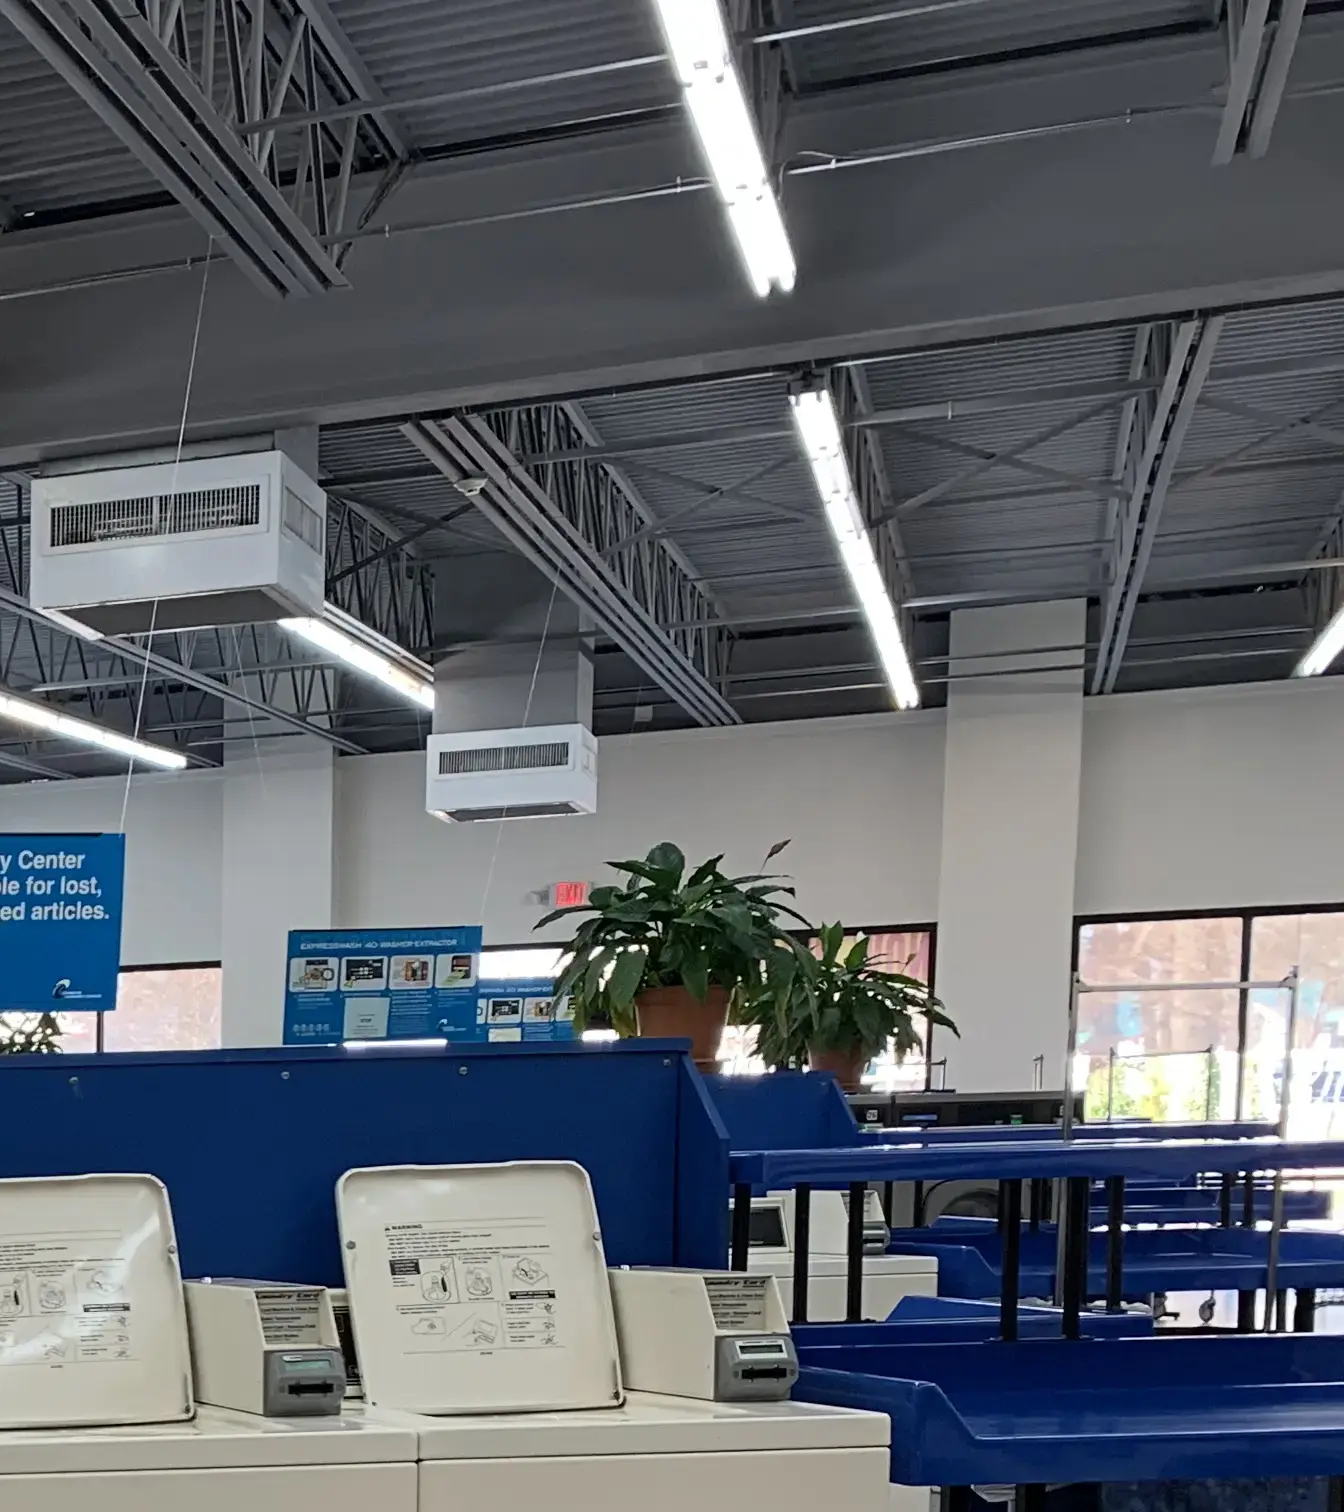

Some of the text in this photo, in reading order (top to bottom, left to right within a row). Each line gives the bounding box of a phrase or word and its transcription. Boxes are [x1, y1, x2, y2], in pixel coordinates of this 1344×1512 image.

[17, 849, 86, 870] Center
[26, 875, 55, 896] for
[60, 875, 102, 897] lost,
[30, 901, 110, 921] articles.
